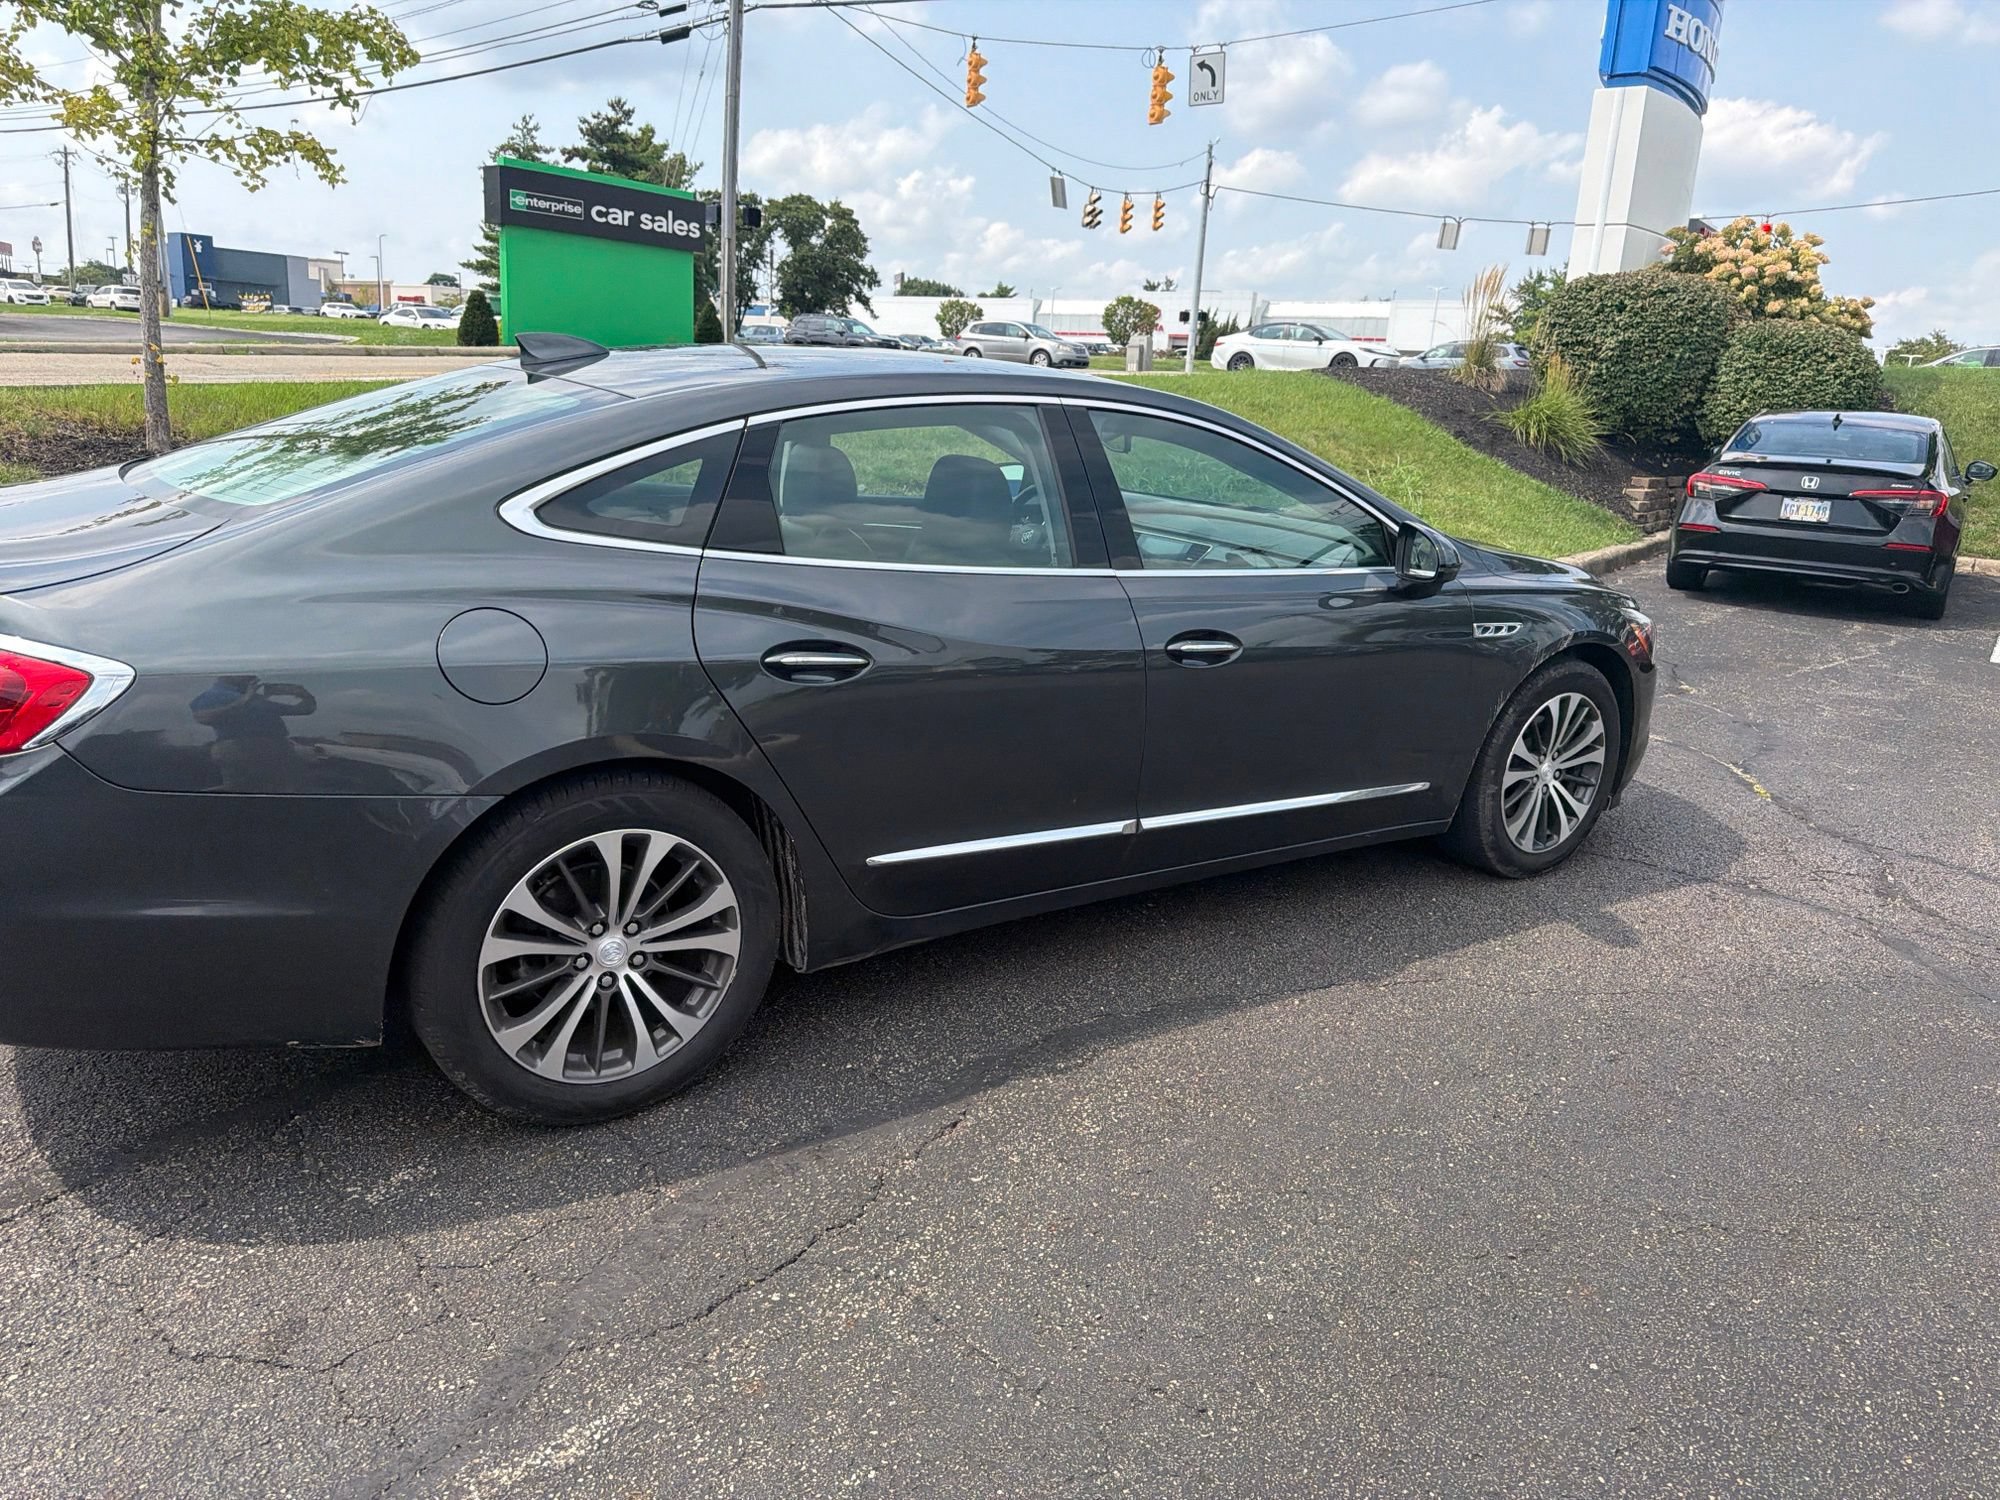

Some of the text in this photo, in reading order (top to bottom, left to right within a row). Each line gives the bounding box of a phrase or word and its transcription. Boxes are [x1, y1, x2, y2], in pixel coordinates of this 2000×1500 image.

[1664, 3, 1718, 65] HON
[1193, 90, 1219, 102] ONLY
[512, 194, 701, 239] enterprise car sales
